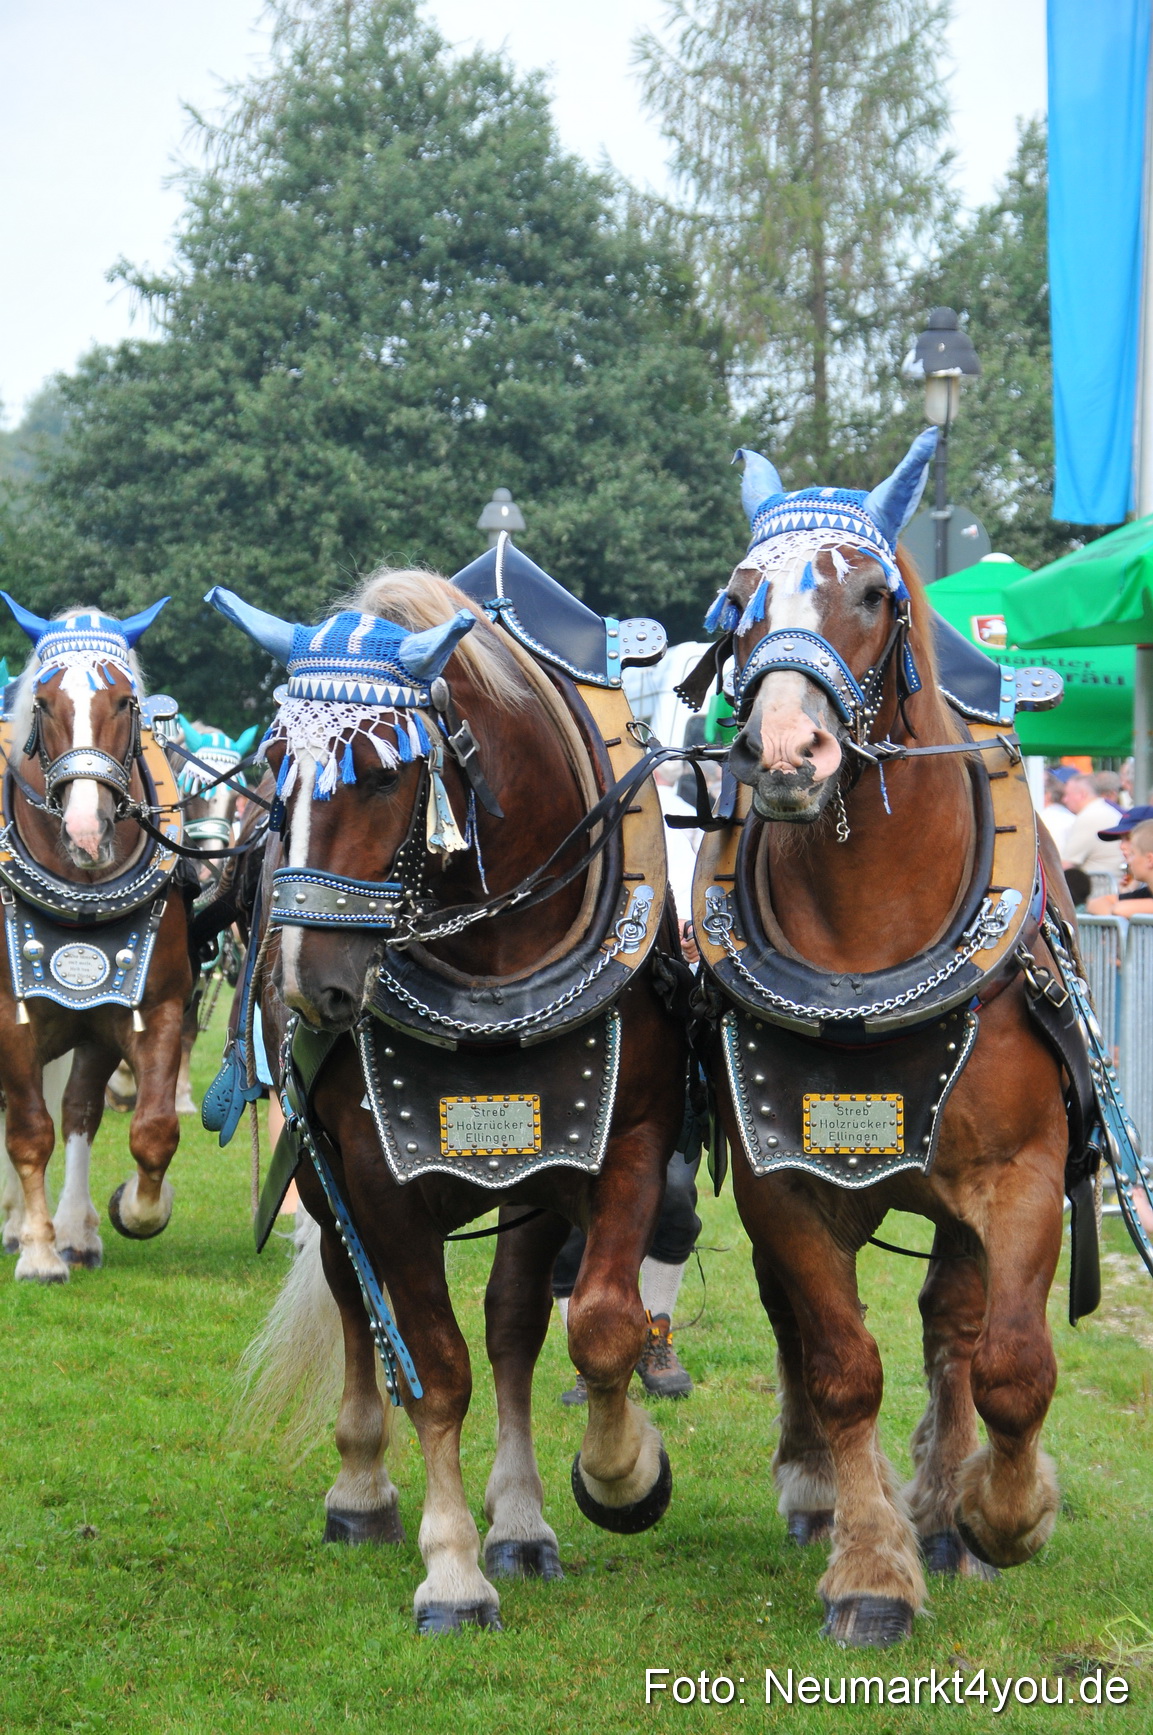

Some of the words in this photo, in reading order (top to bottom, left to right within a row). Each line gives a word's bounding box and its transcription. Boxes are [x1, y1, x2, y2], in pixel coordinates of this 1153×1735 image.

[988, 654, 1095, 669] markter
[1065, 670, 1126, 686] räu
[473, 1107, 506, 1118] Streb
[836, 1106, 869, 1116] Streb
[456, 1120, 524, 1131] Holzrücker
[820, 1119, 887, 1129] Holzrücker
[465, 1132, 515, 1144] Ellingen
[828, 1131, 878, 1143] Ellingen
